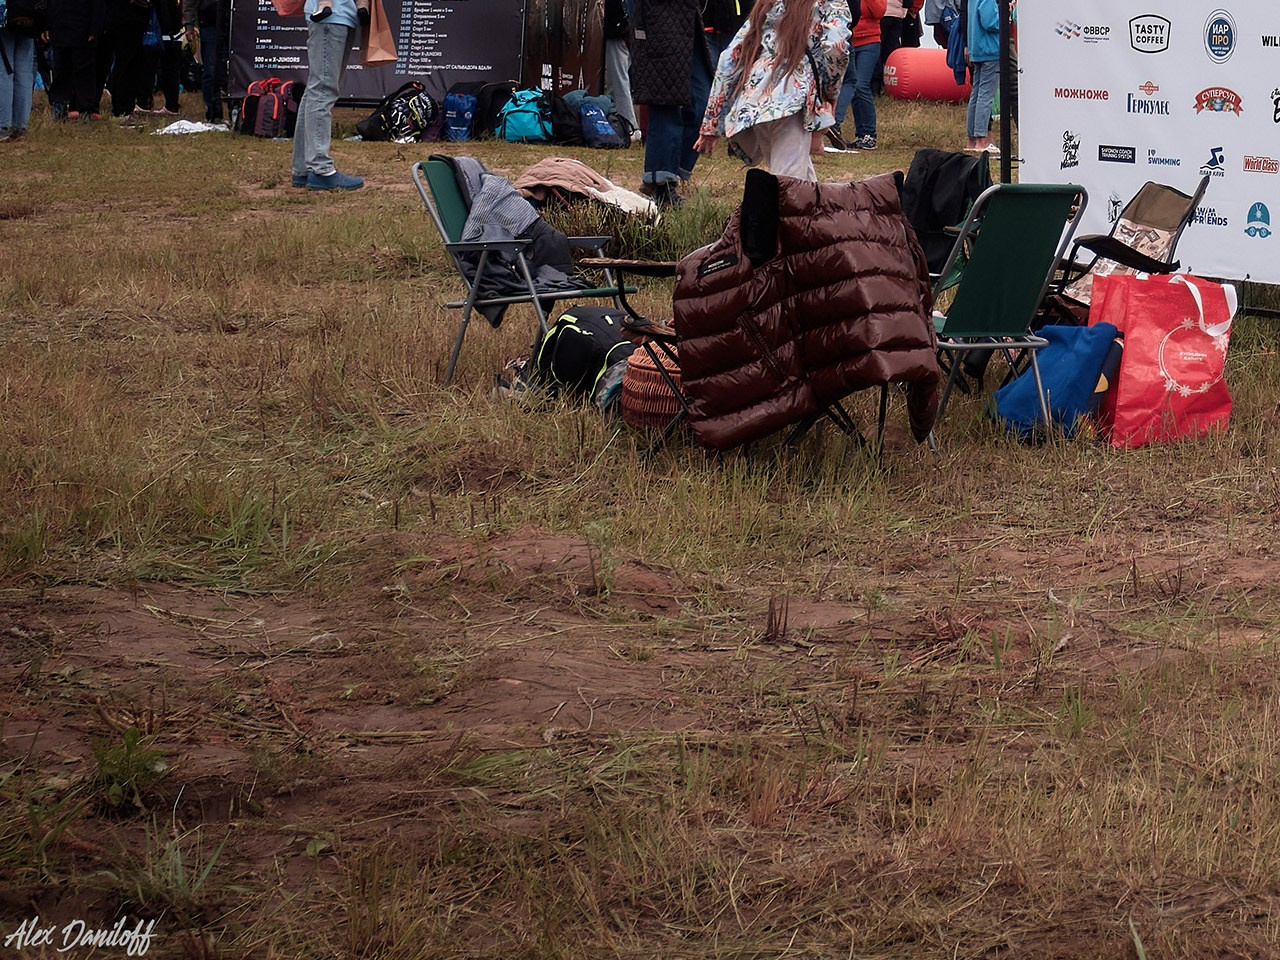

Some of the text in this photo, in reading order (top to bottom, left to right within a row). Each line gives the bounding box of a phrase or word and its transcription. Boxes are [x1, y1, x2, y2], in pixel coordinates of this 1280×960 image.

[1083, 25, 1110, 36] ФВВСР
[1135, 24, 1165, 35] TASTY
[1136, 35, 1164, 45] COFFEE
[1212, 35, 1229, 45] ПРО
[1201, 88, 1236, 102] СУПЕРСУП
[1148, 157, 1181, 166] SWIMMING
[1244, 157, 1279, 172] World Class
